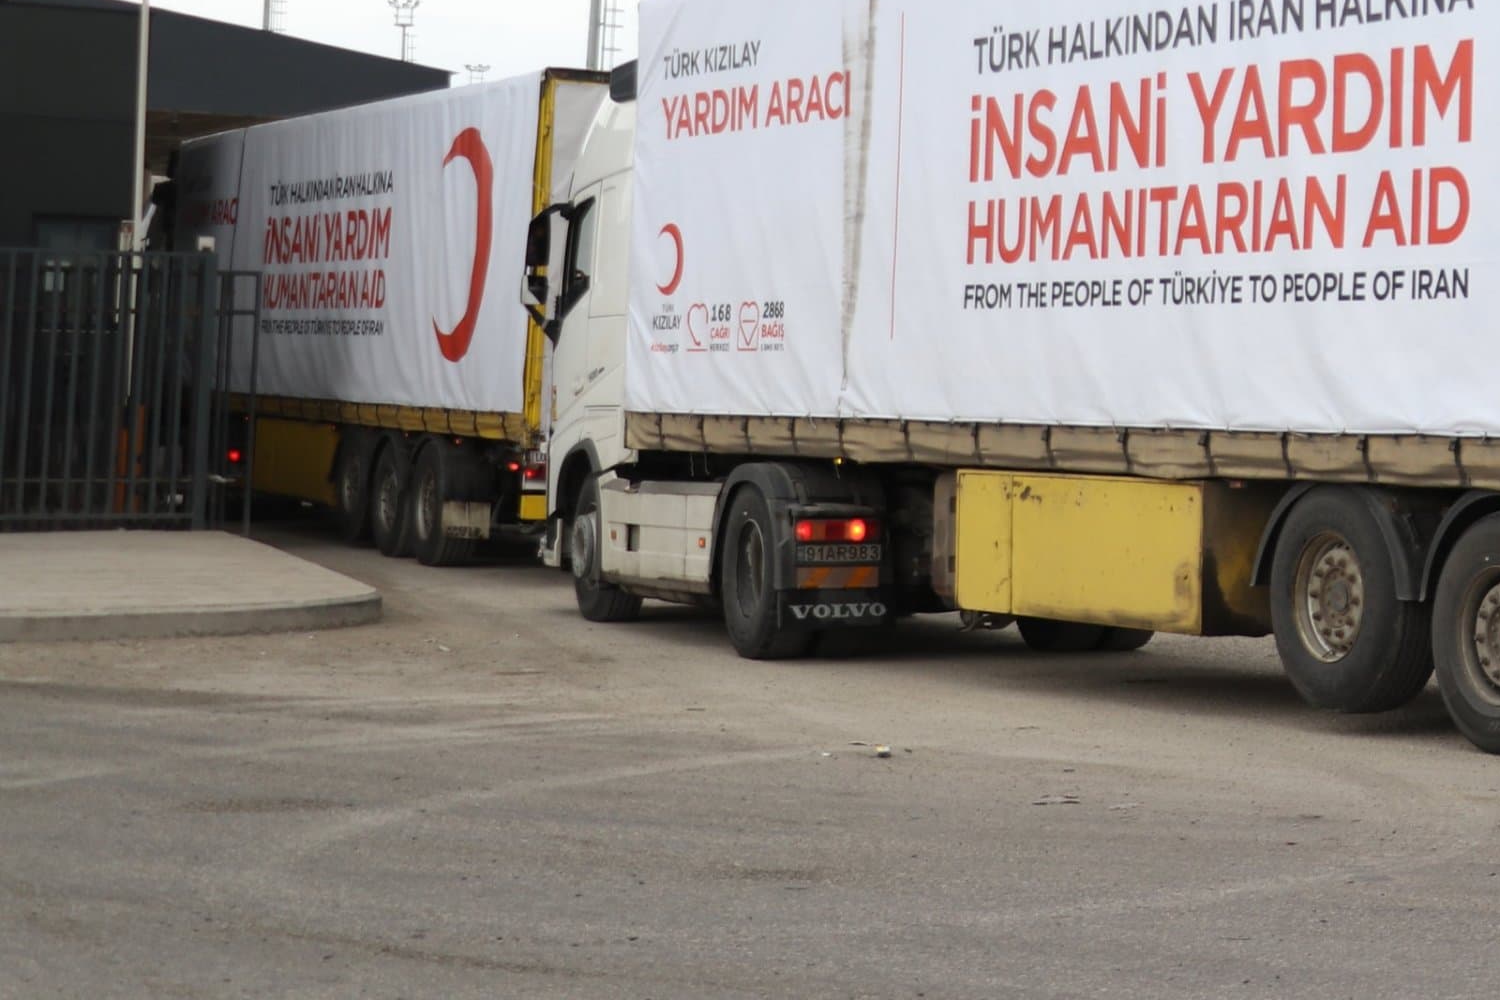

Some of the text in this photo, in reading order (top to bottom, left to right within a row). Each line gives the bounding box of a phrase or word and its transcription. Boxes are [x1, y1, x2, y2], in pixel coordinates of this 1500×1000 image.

[974, 25, 1040, 75] TÜRK
[1047, 2, 1218, 66] HALKINDAN
[664, 40, 761, 80] TÜRK KIZILAY
[661, 70, 852, 140] YARDIM ARACI
[1187, 38, 1474, 164] YARDIM
[324, 207, 392, 262] YARDIM
[966, 166, 1471, 265] HUMANITARIAN AID
[262, 269, 385, 310] HUMANITARIAN AID
[964, 268, 1470, 309] FROM THE PEOPLE OF TÜRKİYE TO PEOPLE OF IRAN
[652, 315, 681, 331] KIZILAY
[711, 304, 731, 322] 168
[763, 301, 785, 319] 2868
[789, 602, 887, 620] VOLVO
